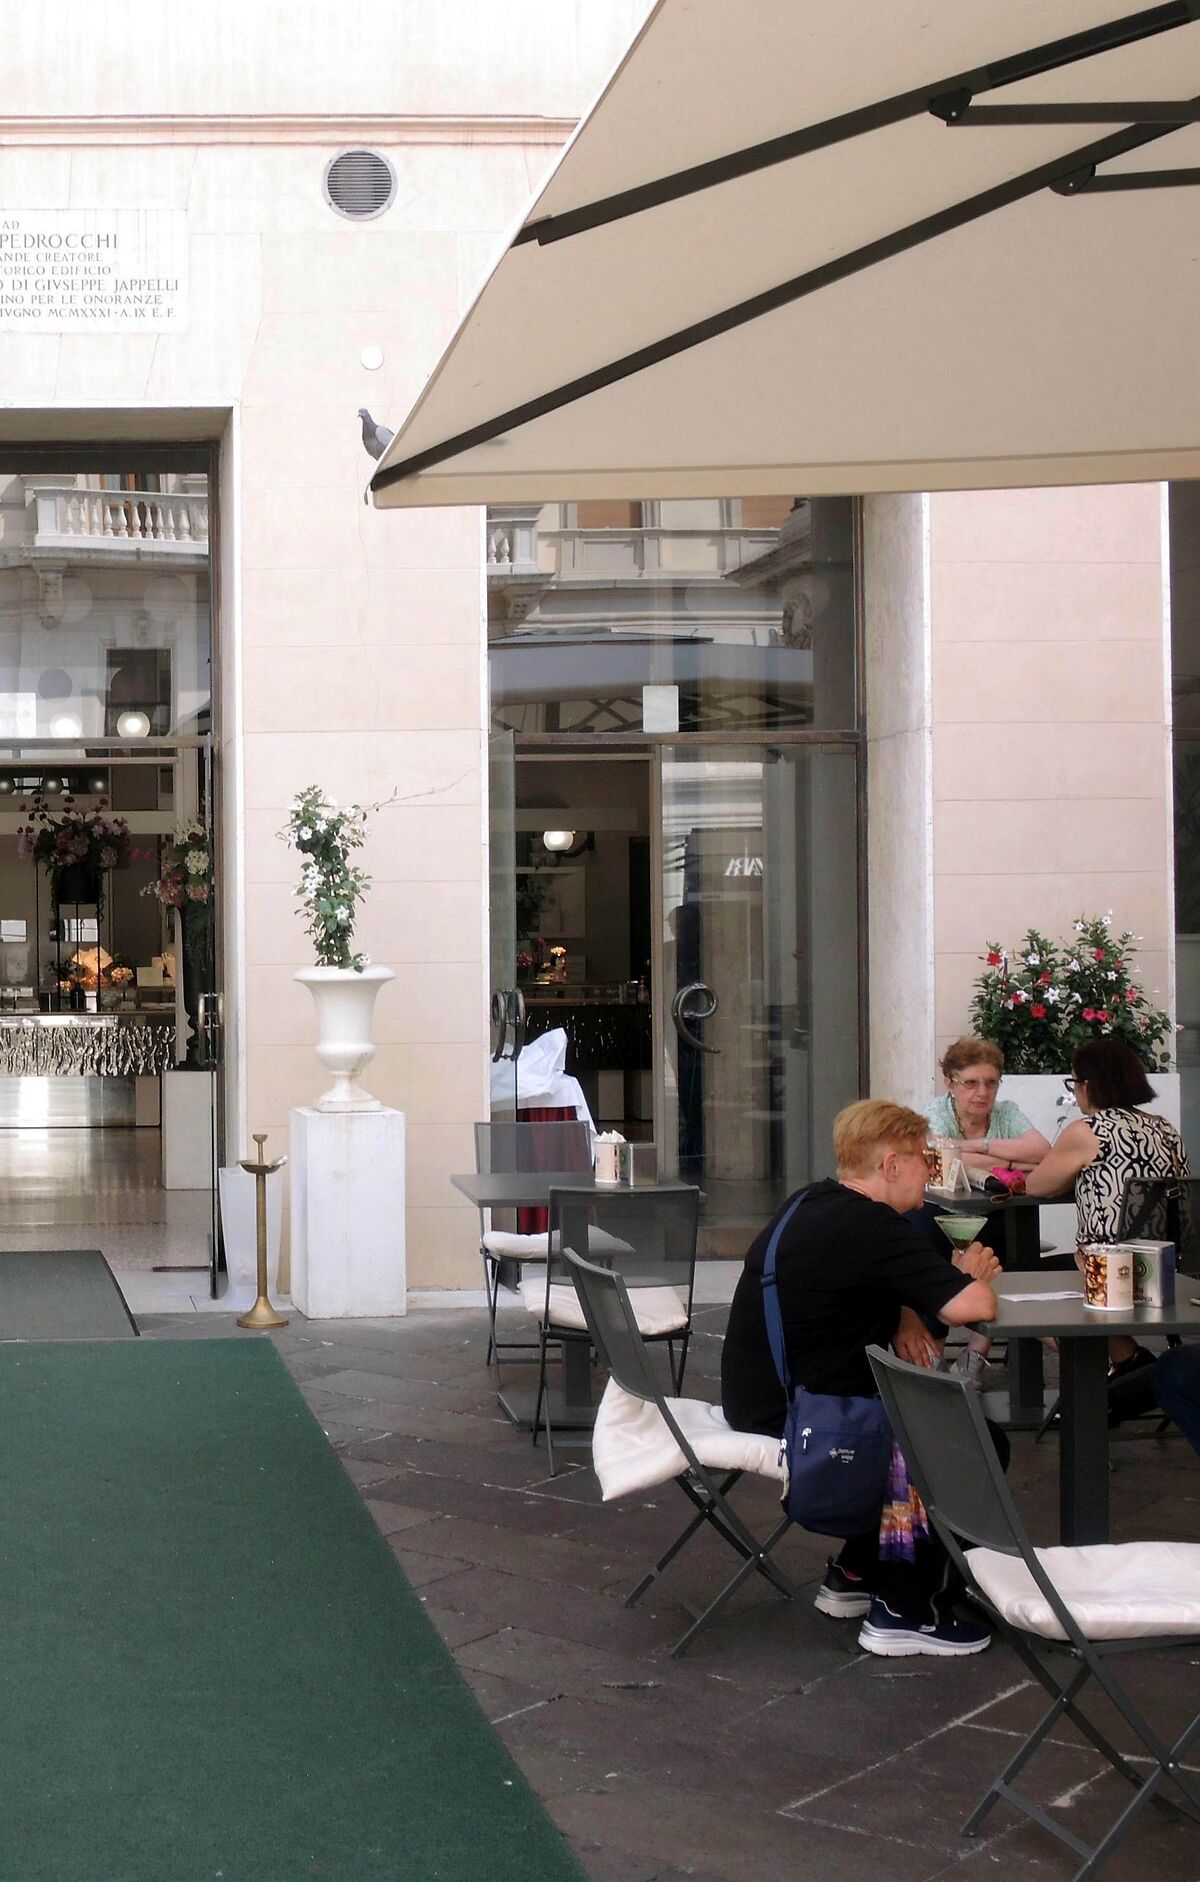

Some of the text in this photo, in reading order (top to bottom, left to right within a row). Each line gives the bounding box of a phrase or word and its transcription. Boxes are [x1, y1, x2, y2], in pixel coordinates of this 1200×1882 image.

[3, 221, 19, 230] AD
[0, 233, 116, 249] PEDROCCHI
[36, 252, 103, 262] CREATORE
[52, 266, 111, 275] EDIFICIO
[12, 279, 27, 291] DI
[35, 279, 105, 291] GIVSEPPE
[114, 279, 178, 293] JAPPELLI
[31, 295, 53, 304] PER
[62, 295, 76, 304] LE
[84, 295, 162, 304] ONORANZE
